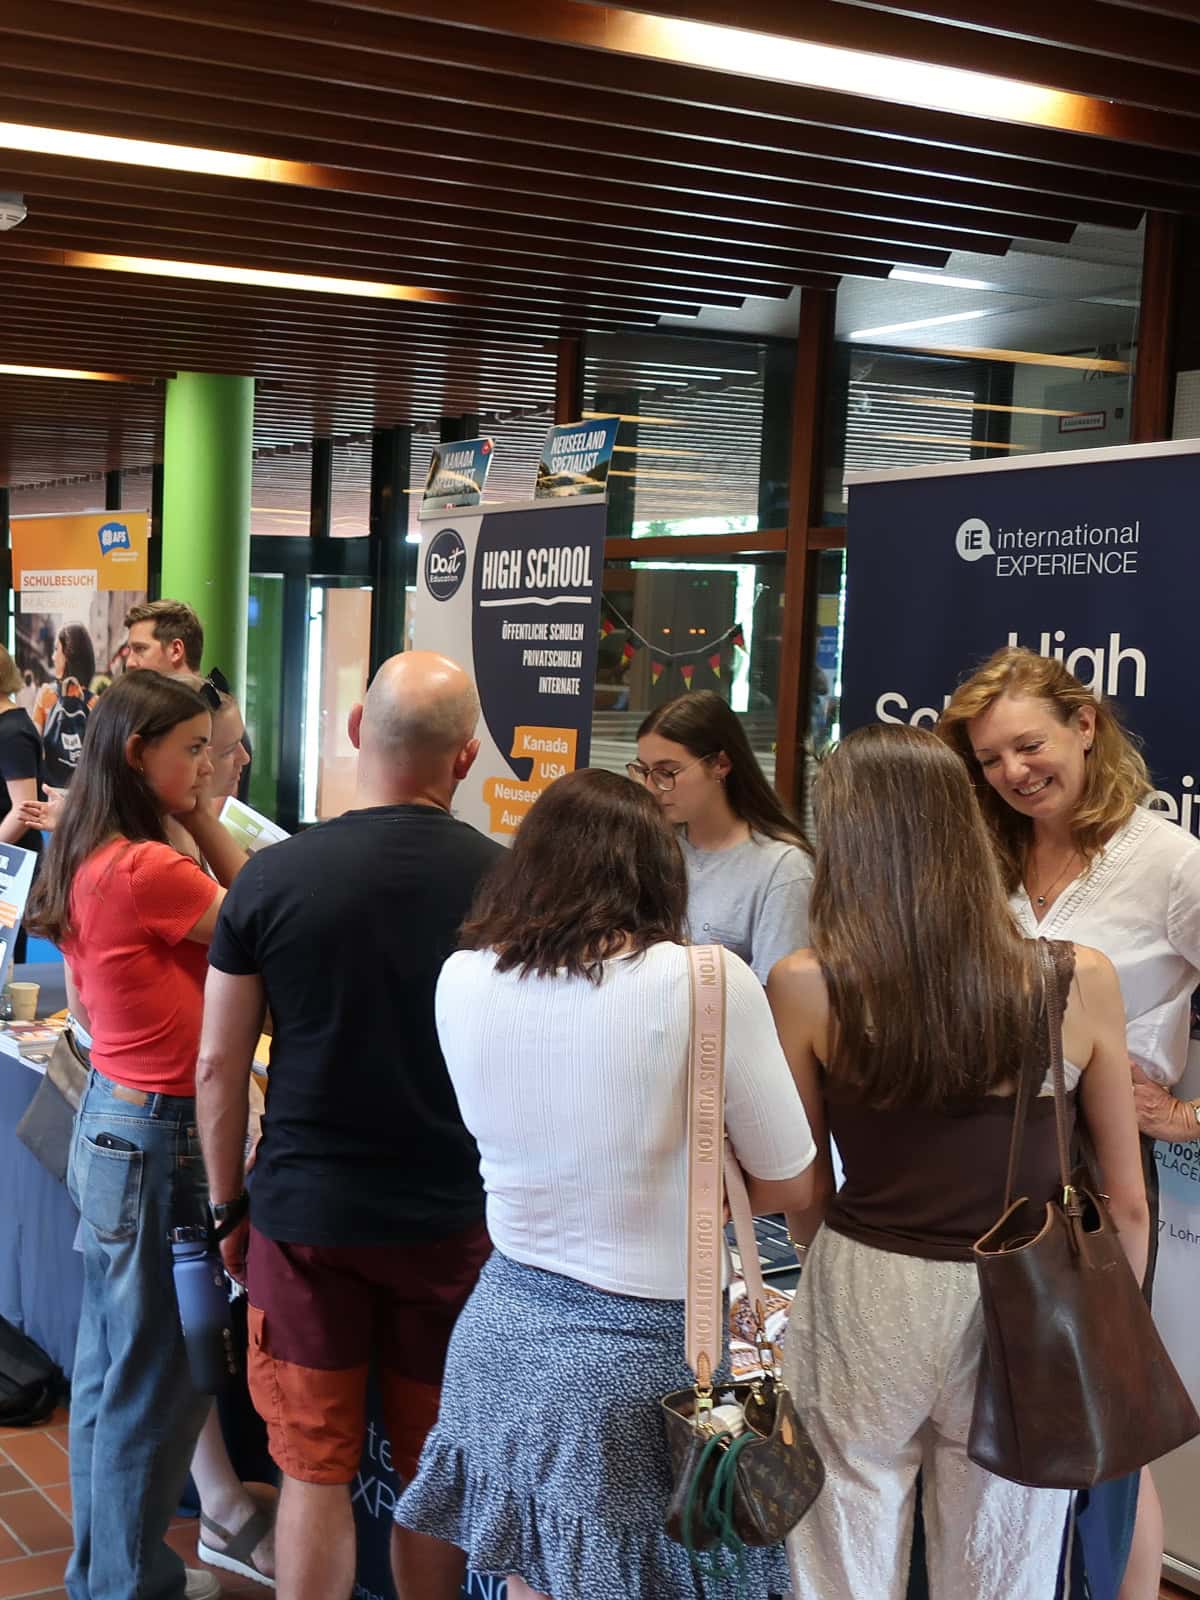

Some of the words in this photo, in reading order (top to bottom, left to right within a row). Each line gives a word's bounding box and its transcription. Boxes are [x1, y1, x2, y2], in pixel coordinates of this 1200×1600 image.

[550, 430, 607, 455] NEUSEELAND
[443, 449, 475, 469] KANADA
[550, 452, 599, 475] SPEZIALIST
[112, 531, 127, 543] AFS
[997, 521, 1140, 549] international
[481, 549, 521, 590] HIGH
[525, 546, 593, 588] SCHOOL
[996, 551, 1138, 577] EXPERIENCE
[23, 575, 95, 587] SCHULBESUCH
[502, 620, 549, 640] ÖFFENTLICHE
[550, 624, 584, 640] SCHULEN
[522, 650, 582, 668] PRIVATSCHULEN
[538, 676, 581, 695] INTERNATE
[523, 734, 568, 753] Kanada
[540, 762, 566, 778] USA
[700, 1032, 717, 1081] LOUIS
[696, 1087, 717, 1163] VUITTON
[1153, 1150, 1200, 1183] PLACE
[696, 1211, 713, 1259] LOUIS
[696, 1267, 713, 1346] VUITTON
